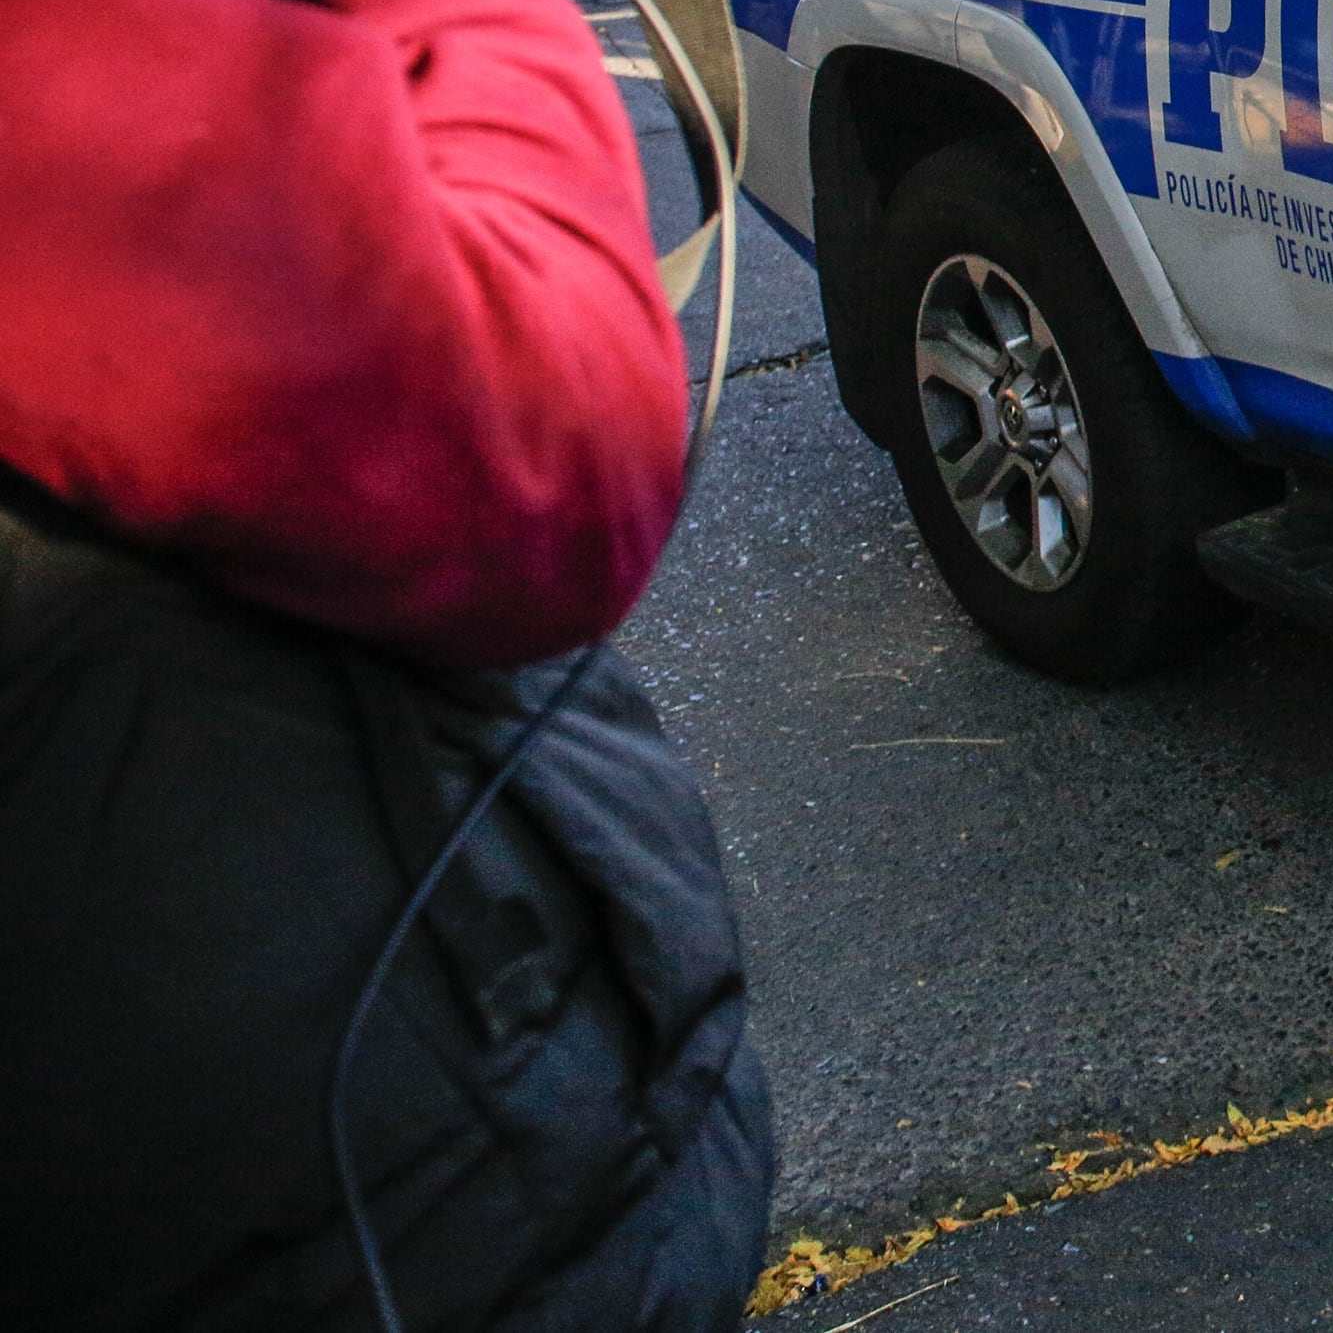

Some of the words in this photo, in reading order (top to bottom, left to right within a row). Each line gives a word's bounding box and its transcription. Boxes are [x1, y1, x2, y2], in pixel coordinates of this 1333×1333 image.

[1166, 171, 1253, 220] POLICÍA
[1258, 188, 1281, 226] DE
[1275, 234, 1299, 270] DE
